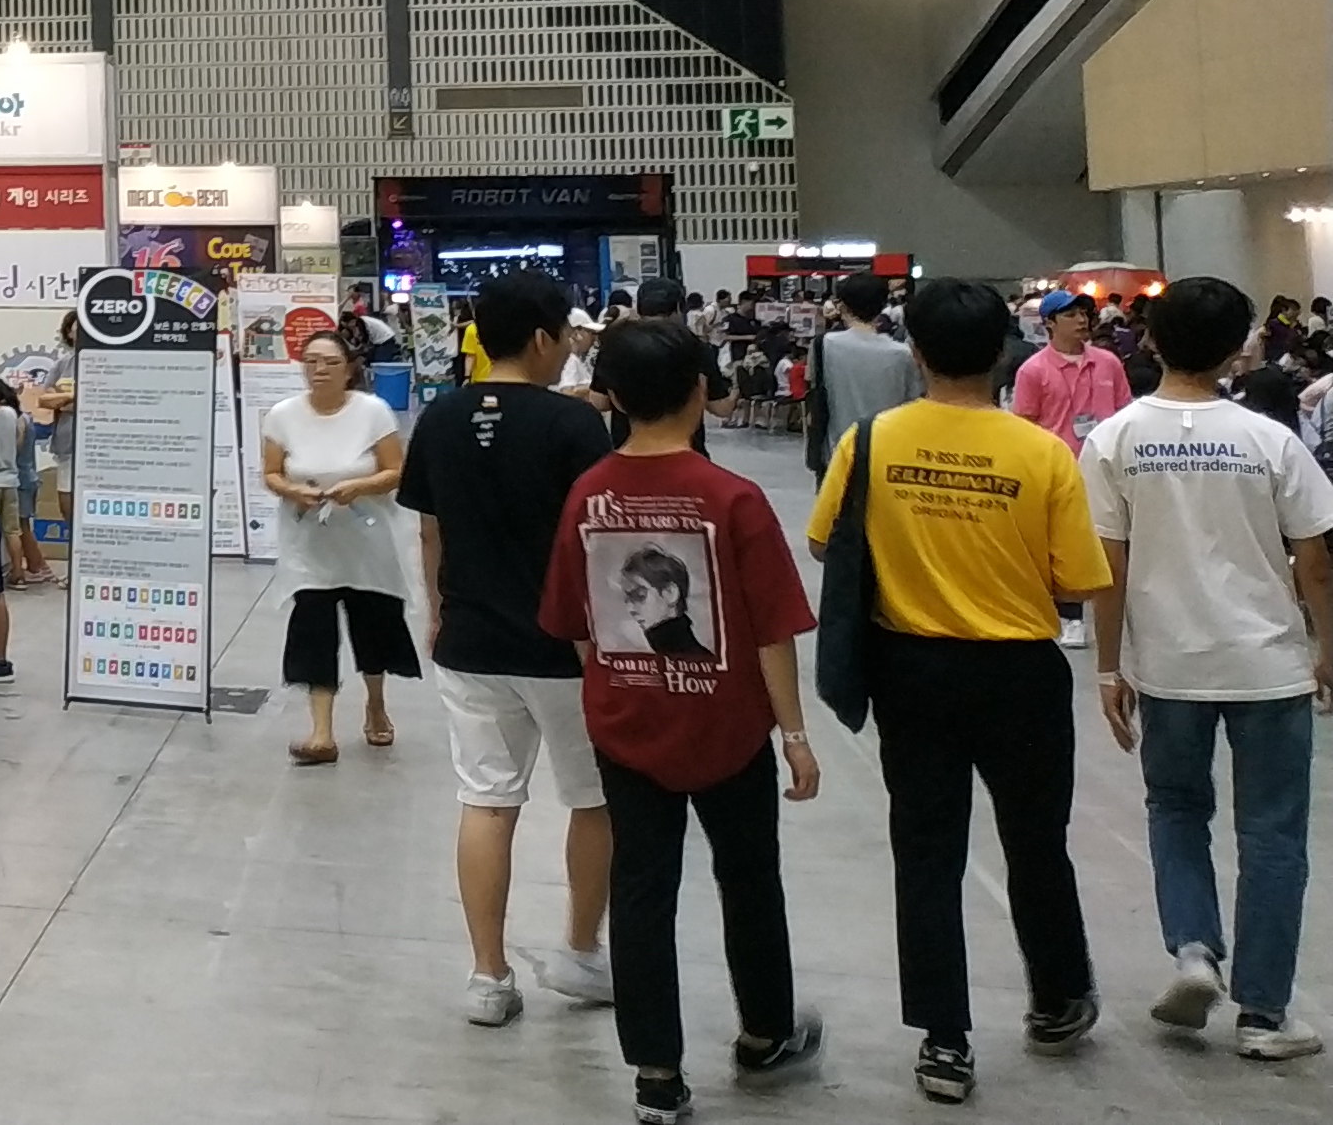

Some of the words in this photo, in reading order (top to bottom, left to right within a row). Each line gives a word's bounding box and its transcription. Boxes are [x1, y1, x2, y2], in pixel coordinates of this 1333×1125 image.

[6, 186, 39, 207] 게임
[44, 189, 90, 205] 시리즈
[452, 188, 531, 205] ROBOT
[542, 188, 591, 205] VAN
[207, 236, 253, 259] CODE
[90, 300, 143, 314] ZERO
[1134, 443, 1248, 459] NOMANUAL.
[1190, 460, 1266, 476] trademark
[663, 655, 713, 673] know
